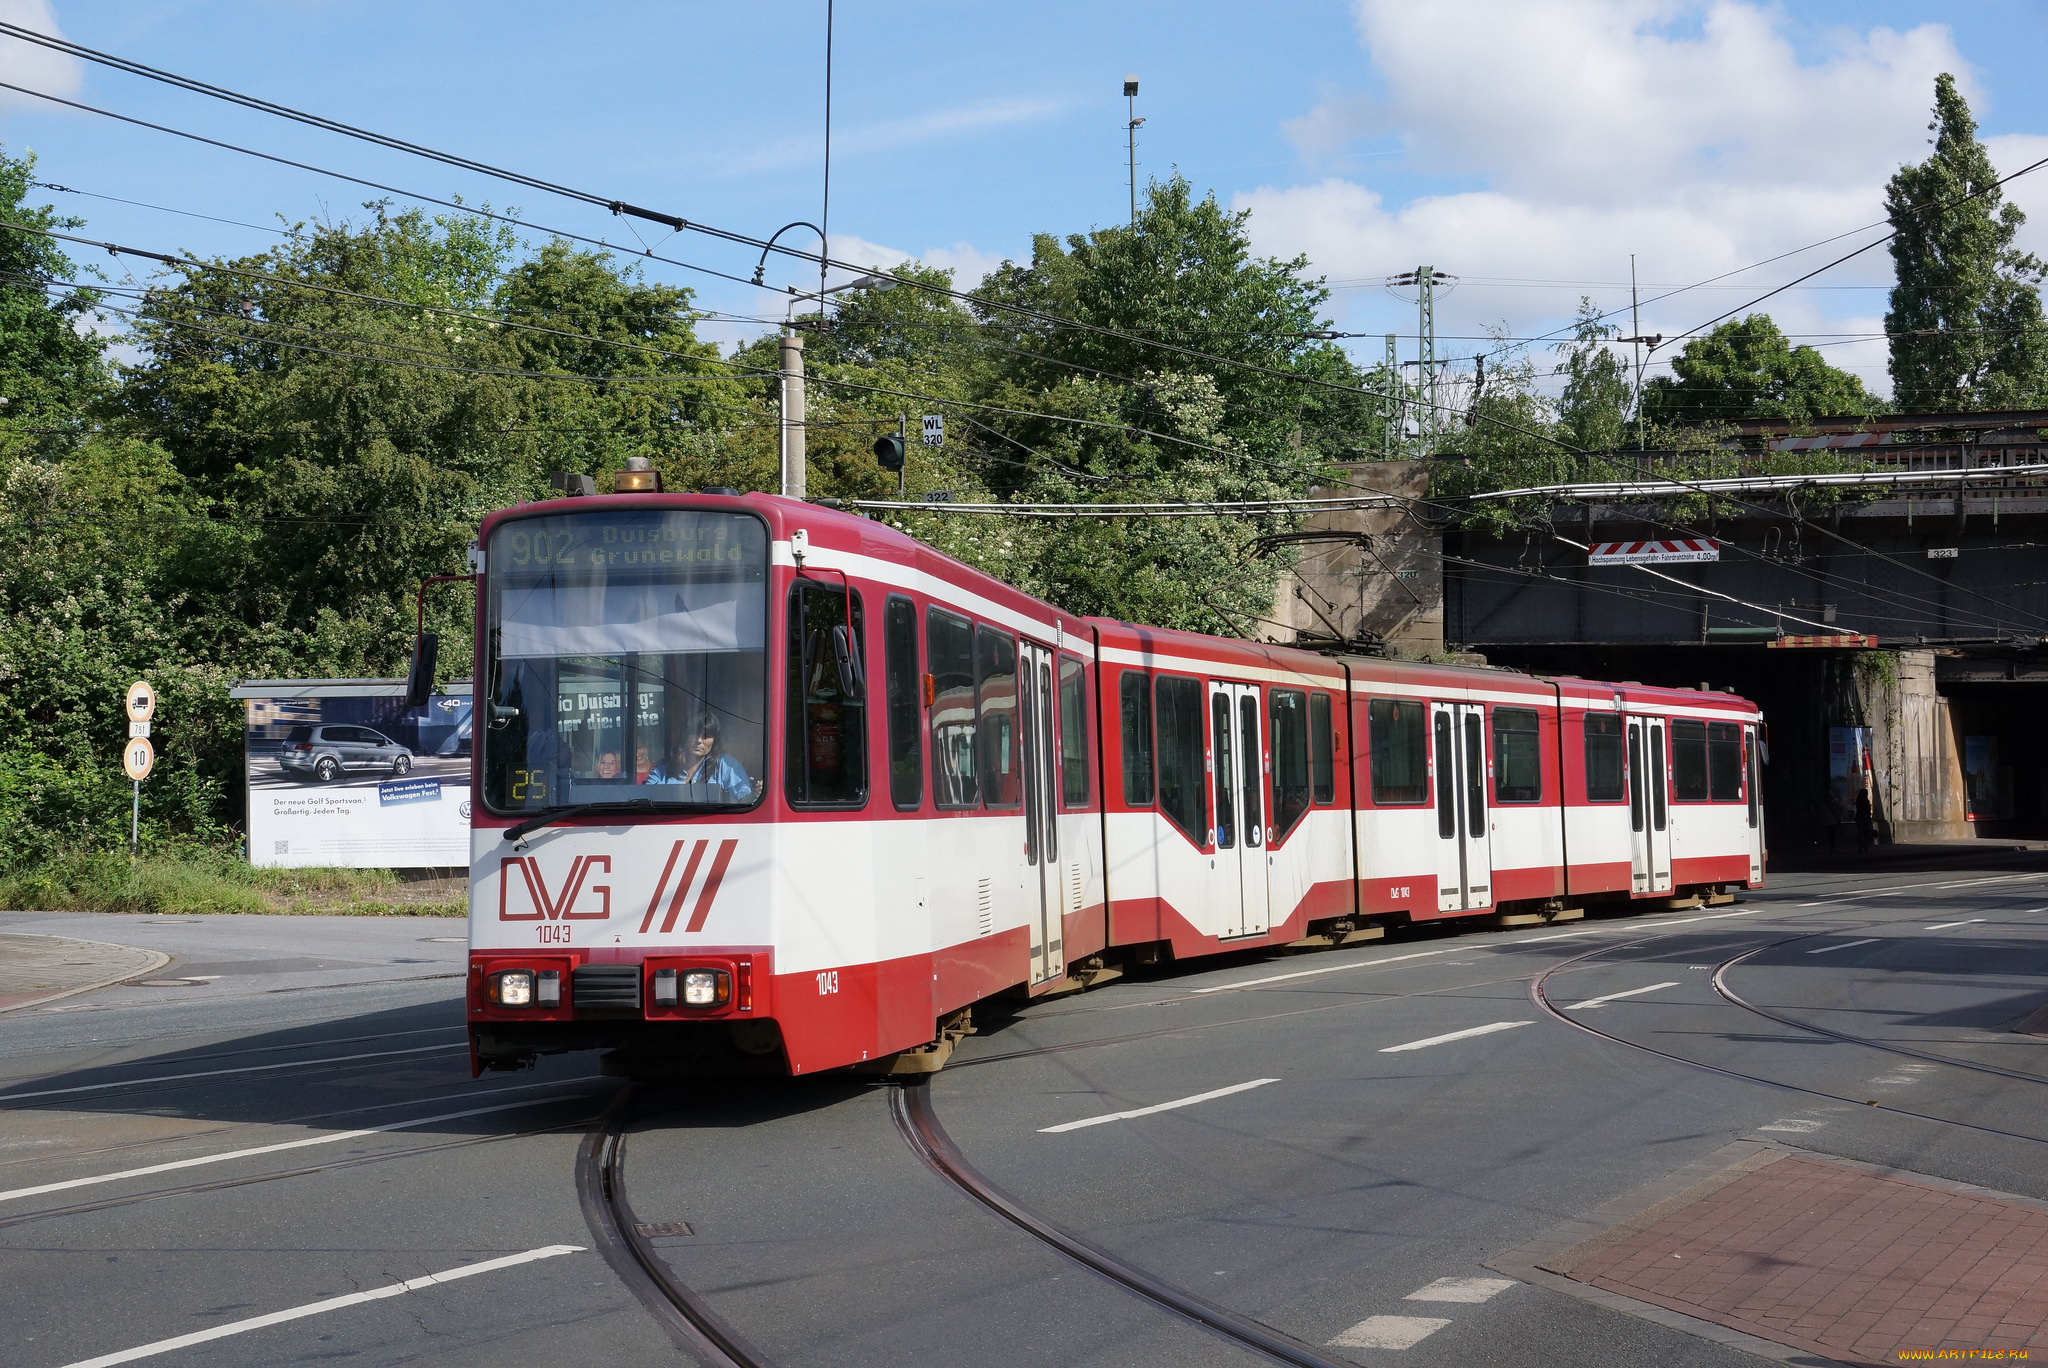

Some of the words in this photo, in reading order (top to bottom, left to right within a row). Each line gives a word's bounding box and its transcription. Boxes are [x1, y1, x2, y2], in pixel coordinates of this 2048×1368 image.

[923, 419, 942, 430] WL
[924, 434, 943, 445] 320
[927, 493, 949, 502] 322
[511, 530, 575, 564] 902
[603, 525, 728, 543] Duisburg
[590, 543, 742, 565] Grunewald
[1933, 549, 1953, 558] 323
[1592, 556, 1626, 564] Hochspannung
[443, 699, 461, 707] 40
[134, 750, 146, 766] 10
[512, 769, 546, 800] 25
[307, 797, 324, 805] Golf
[381, 791, 421, 801] Volkswagen
[273, 808, 312, 816] Großartig.
[336, 807, 352, 816] Tag.
[499, 854, 612, 922] DVG
[536, 925, 571, 943] 1043
[816, 971, 838, 996] 1043
